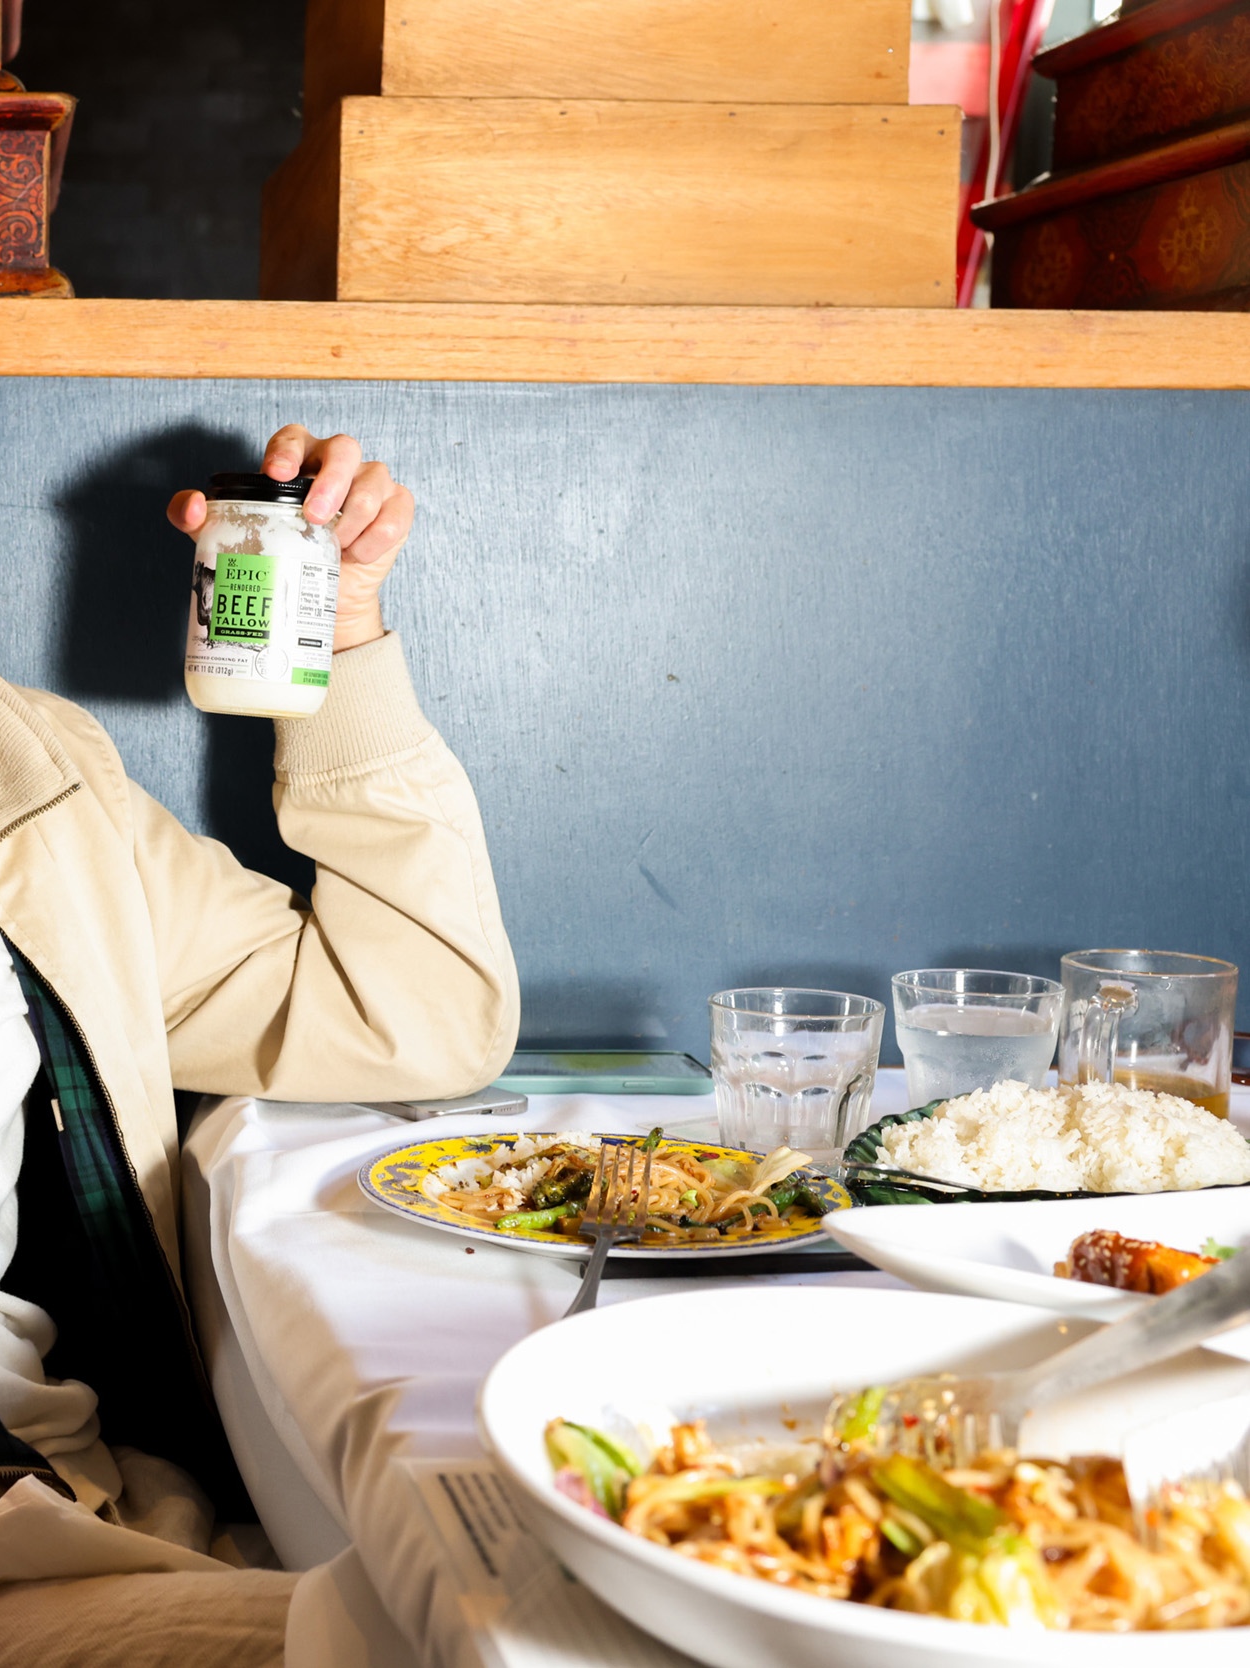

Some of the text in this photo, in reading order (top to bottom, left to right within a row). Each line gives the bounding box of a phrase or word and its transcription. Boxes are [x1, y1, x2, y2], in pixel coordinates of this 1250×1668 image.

[226, 568, 267, 582] EPIC
[230, 583, 261, 592] RENDERED
[217, 594, 272, 617] BEEF
[215, 617, 270, 628] TALLOW
[220, 629, 264, 637] GRASS-FED
[207, 666, 214, 674] OZ
[215, 666, 234, 676] (312g)
